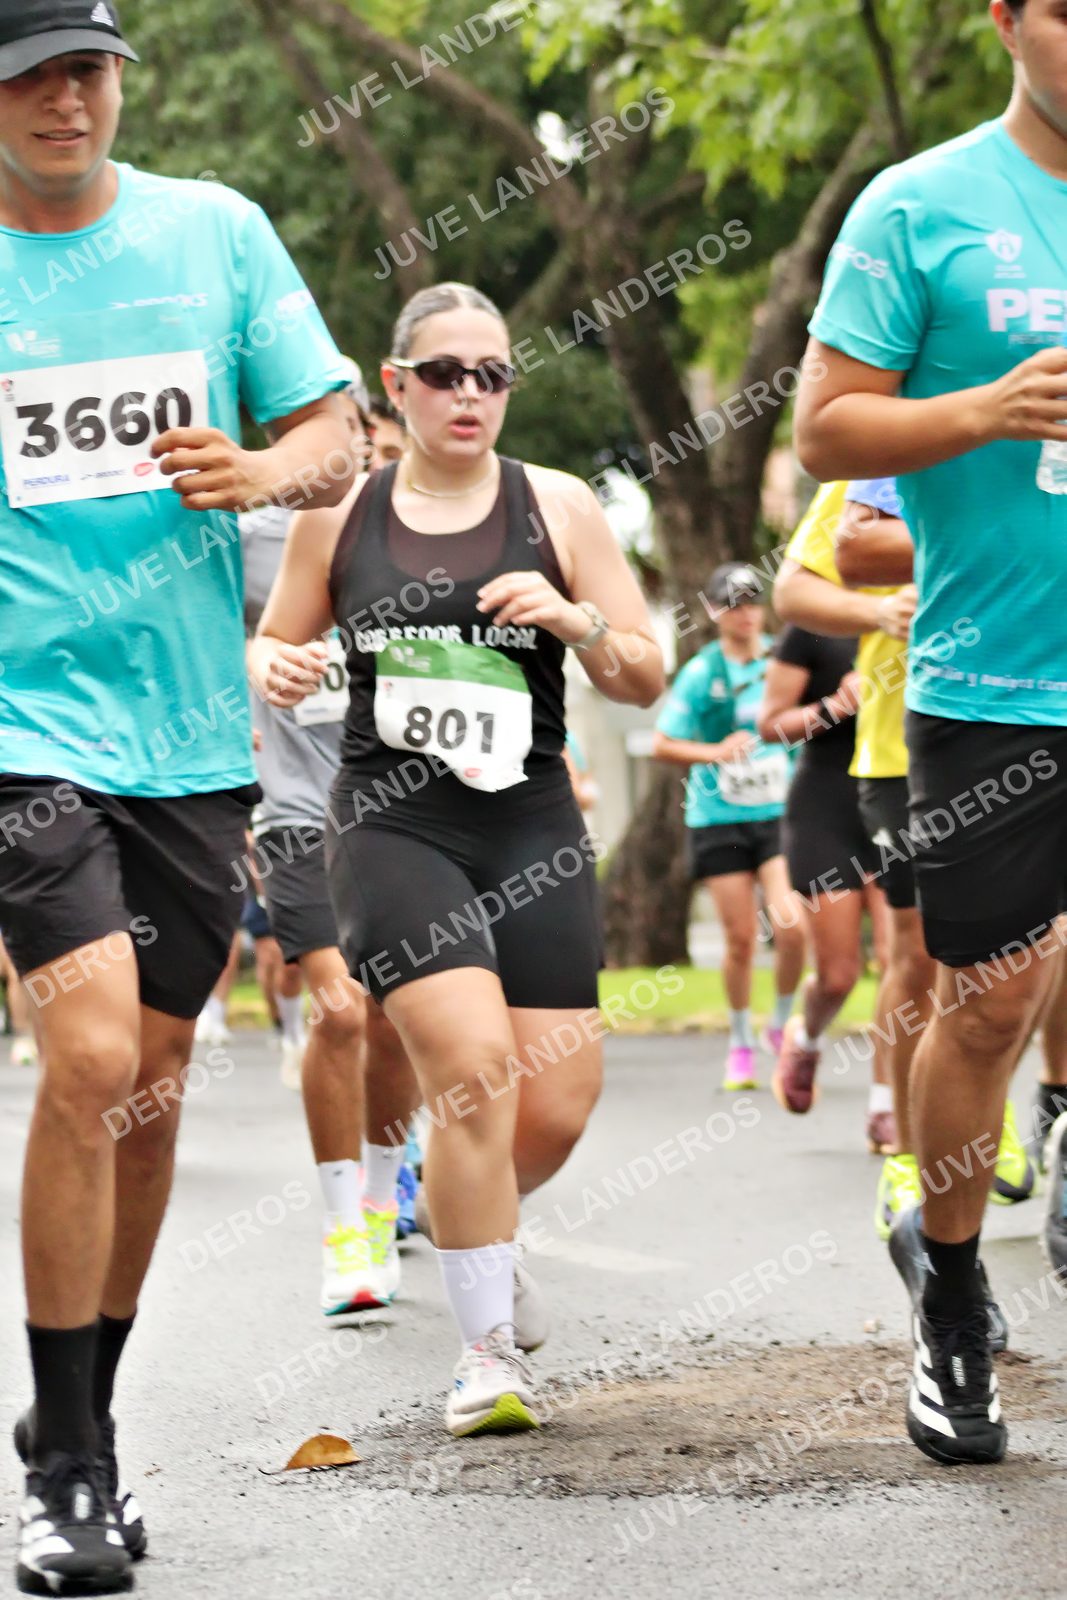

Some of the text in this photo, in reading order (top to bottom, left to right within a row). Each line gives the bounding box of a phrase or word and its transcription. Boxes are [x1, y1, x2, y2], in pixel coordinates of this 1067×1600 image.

[16, 387, 191, 458] 3660
[472, 624, 537, 650] LOCAL
[403, 706, 494, 754] 801
